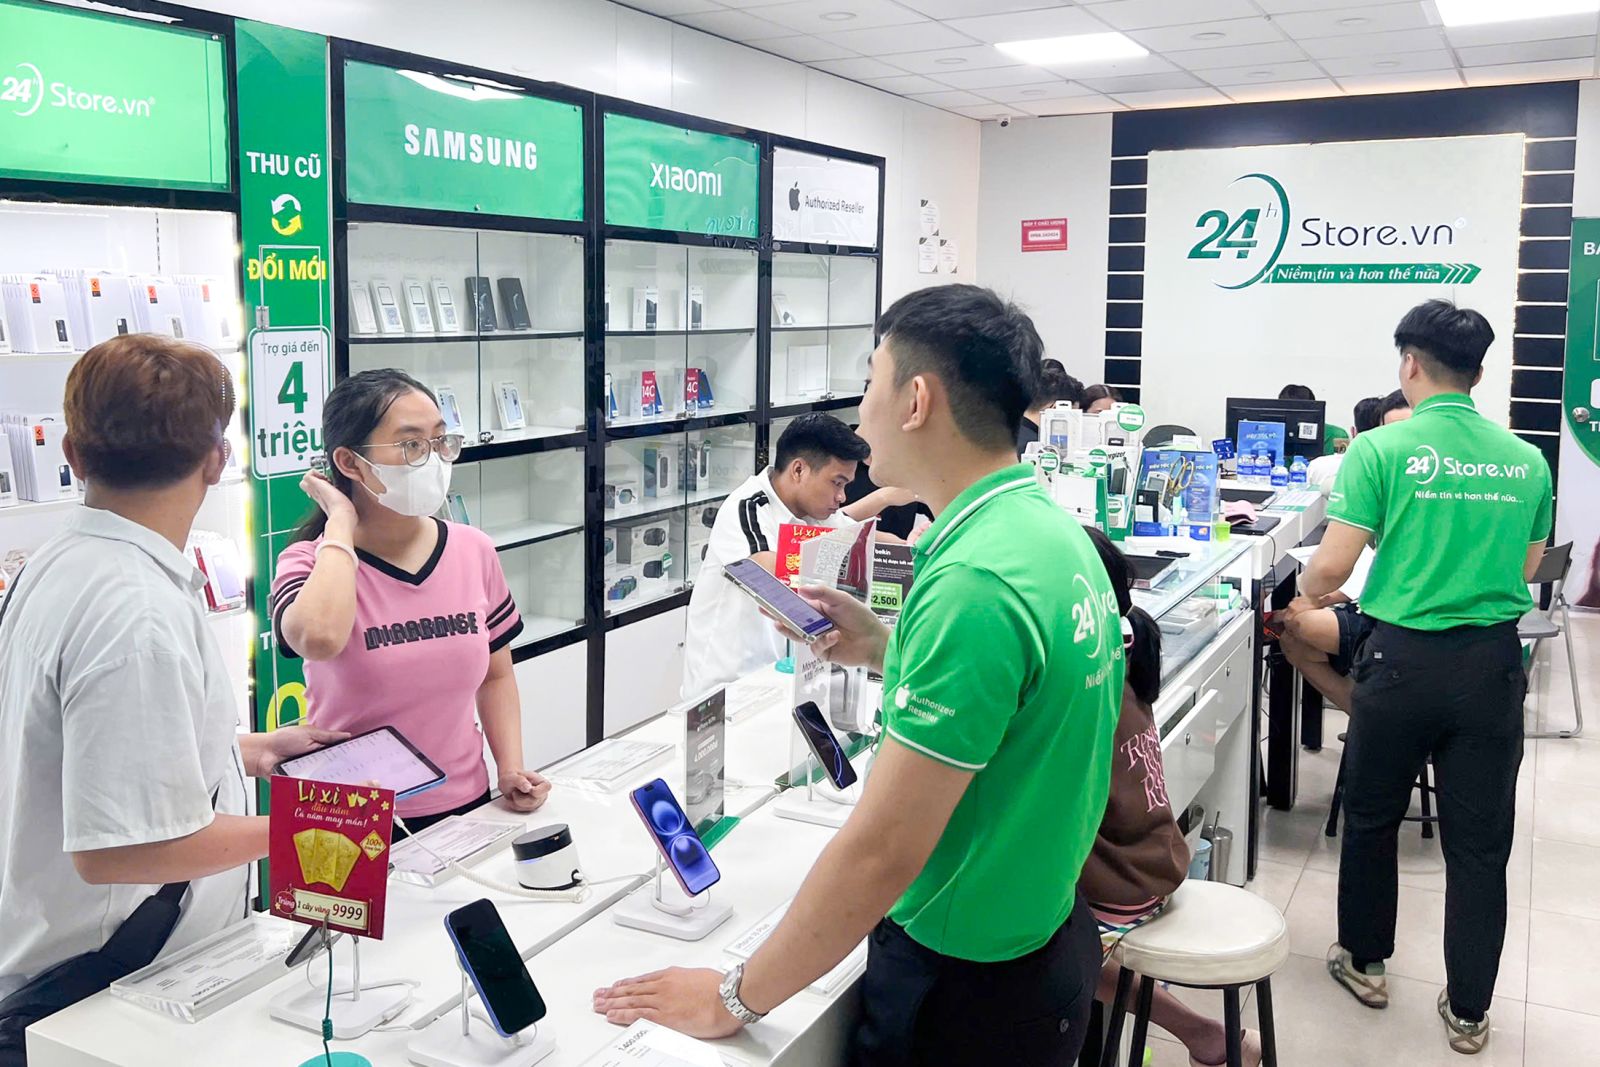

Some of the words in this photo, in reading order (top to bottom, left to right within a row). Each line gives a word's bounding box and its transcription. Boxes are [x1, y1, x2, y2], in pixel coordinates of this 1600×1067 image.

[404, 123, 538, 170] SAMSUNG
[246, 151, 289, 176] THU
[294, 154, 321, 178] CŨ
[804, 195, 840, 212] Authorized
[841, 199, 865, 214] Reseller
[1300, 217, 1454, 247] Store.vn
[247, 252, 284, 281] ĐỔI
[289, 254, 327, 281] MỚI
[1276, 266, 1314, 280] Niềm
[1316, 267, 1335, 280] tin
[1340, 267, 1356, 280] và
[1358, 267, 1385, 280] hơn
[1388, 264, 1412, 280] thế
[1414, 266, 1440, 280] nữa
[261, 343, 279, 356] Trợ
[281, 341, 297, 356] giá
[300, 339, 320, 352] đến
[277, 361, 308, 414] 4
[686, 381, 698, 393] 4C
[257, 420, 325, 461] triệu
[1443, 457, 1525, 480] Store.vn
[1439, 491, 1452, 499] tin
[907, 705, 938, 723] Reseller
[910, 694, 956, 717] Authorized
[298, 781, 316, 802] Lì
[320, 786, 341, 805] xì
[325, 816, 343, 828] may
[302, 902, 314, 913] cây
[332, 903, 363, 921] 9999
